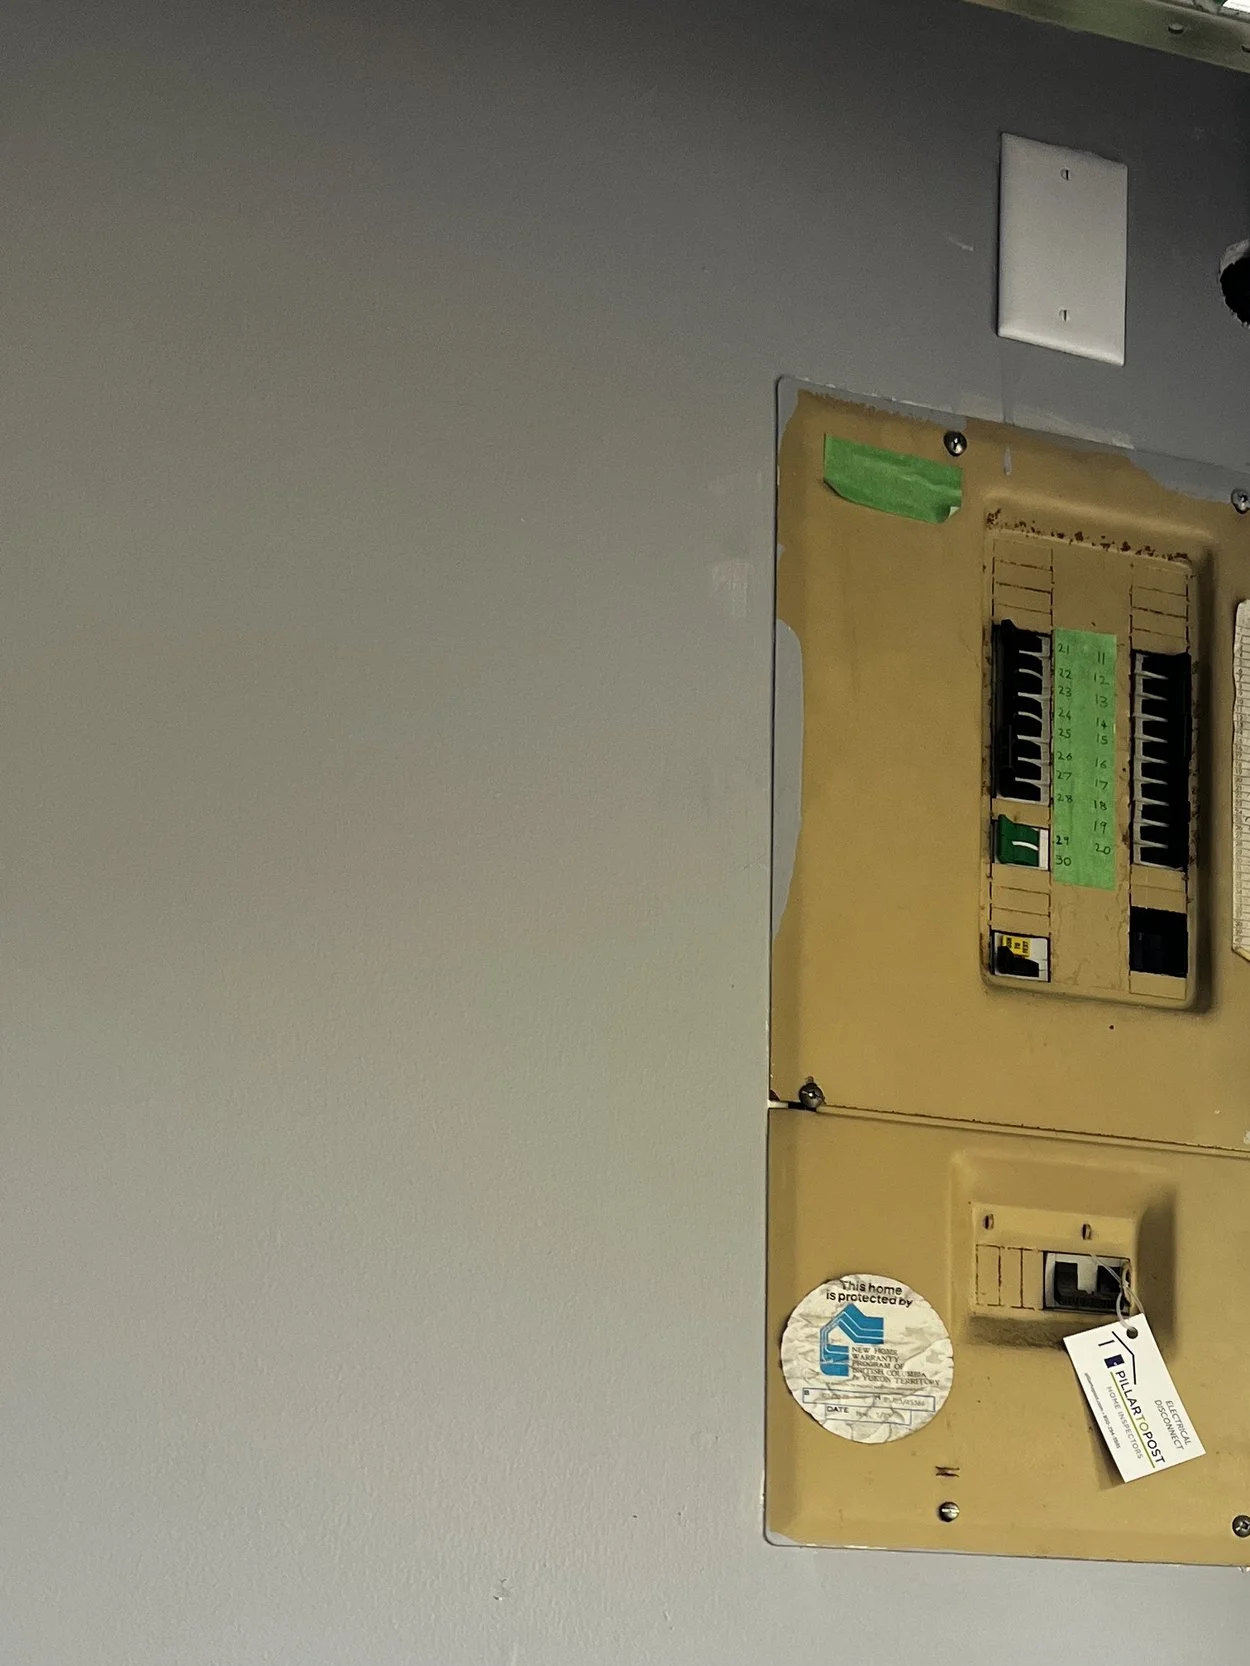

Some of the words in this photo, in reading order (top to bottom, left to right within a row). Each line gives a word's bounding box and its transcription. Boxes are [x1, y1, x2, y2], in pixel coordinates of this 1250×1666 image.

[1058, 643, 1070, 655] 21
[1058, 668, 1072, 680] 22
[1094, 672, 1110, 686] 12
[1058, 685, 1072, 698] 23
[1095, 693, 1109, 708] 13
[1058, 707, 1072, 721] 24
[1096, 716, 1108, 730] 14
[1058, 727, 1072, 739] 25
[1096, 733, 1109, 746] 15
[1057, 750, 1073, 761] 26
[1095, 756, 1108, 769] 16
[1056, 769, 1073, 780] 27
[1094, 778, 1109, 791] 17
[1057, 792, 1073, 804] 28
[1093, 799, 1108, 812] 18
[1093, 819, 1108, 834] 19
[1094, 842, 1112, 855] 20
[1055, 855, 1072, 867] 30
[841, 1280, 866, 1292] This
[868, 1282, 903, 1296] home
[826, 1291, 836, 1301] is
[838, 1292, 896, 1305] protected
[899, 1296, 913, 1308] by
[852, 1346, 871, 1354] NEW
[852, 1353, 900, 1363] WARRANTY
[852, 1360, 891, 1369] PROGRAM
[826, 1404, 850, 1414] DATE
[1107, 1385, 1121, 1411] HOME
[1118, 1410, 1144, 1459] INSPECTORS
[1154, 1398, 1185, 1451] DISCONNECT
[1165, 1399, 1192, 1446] ELECTRICAL
